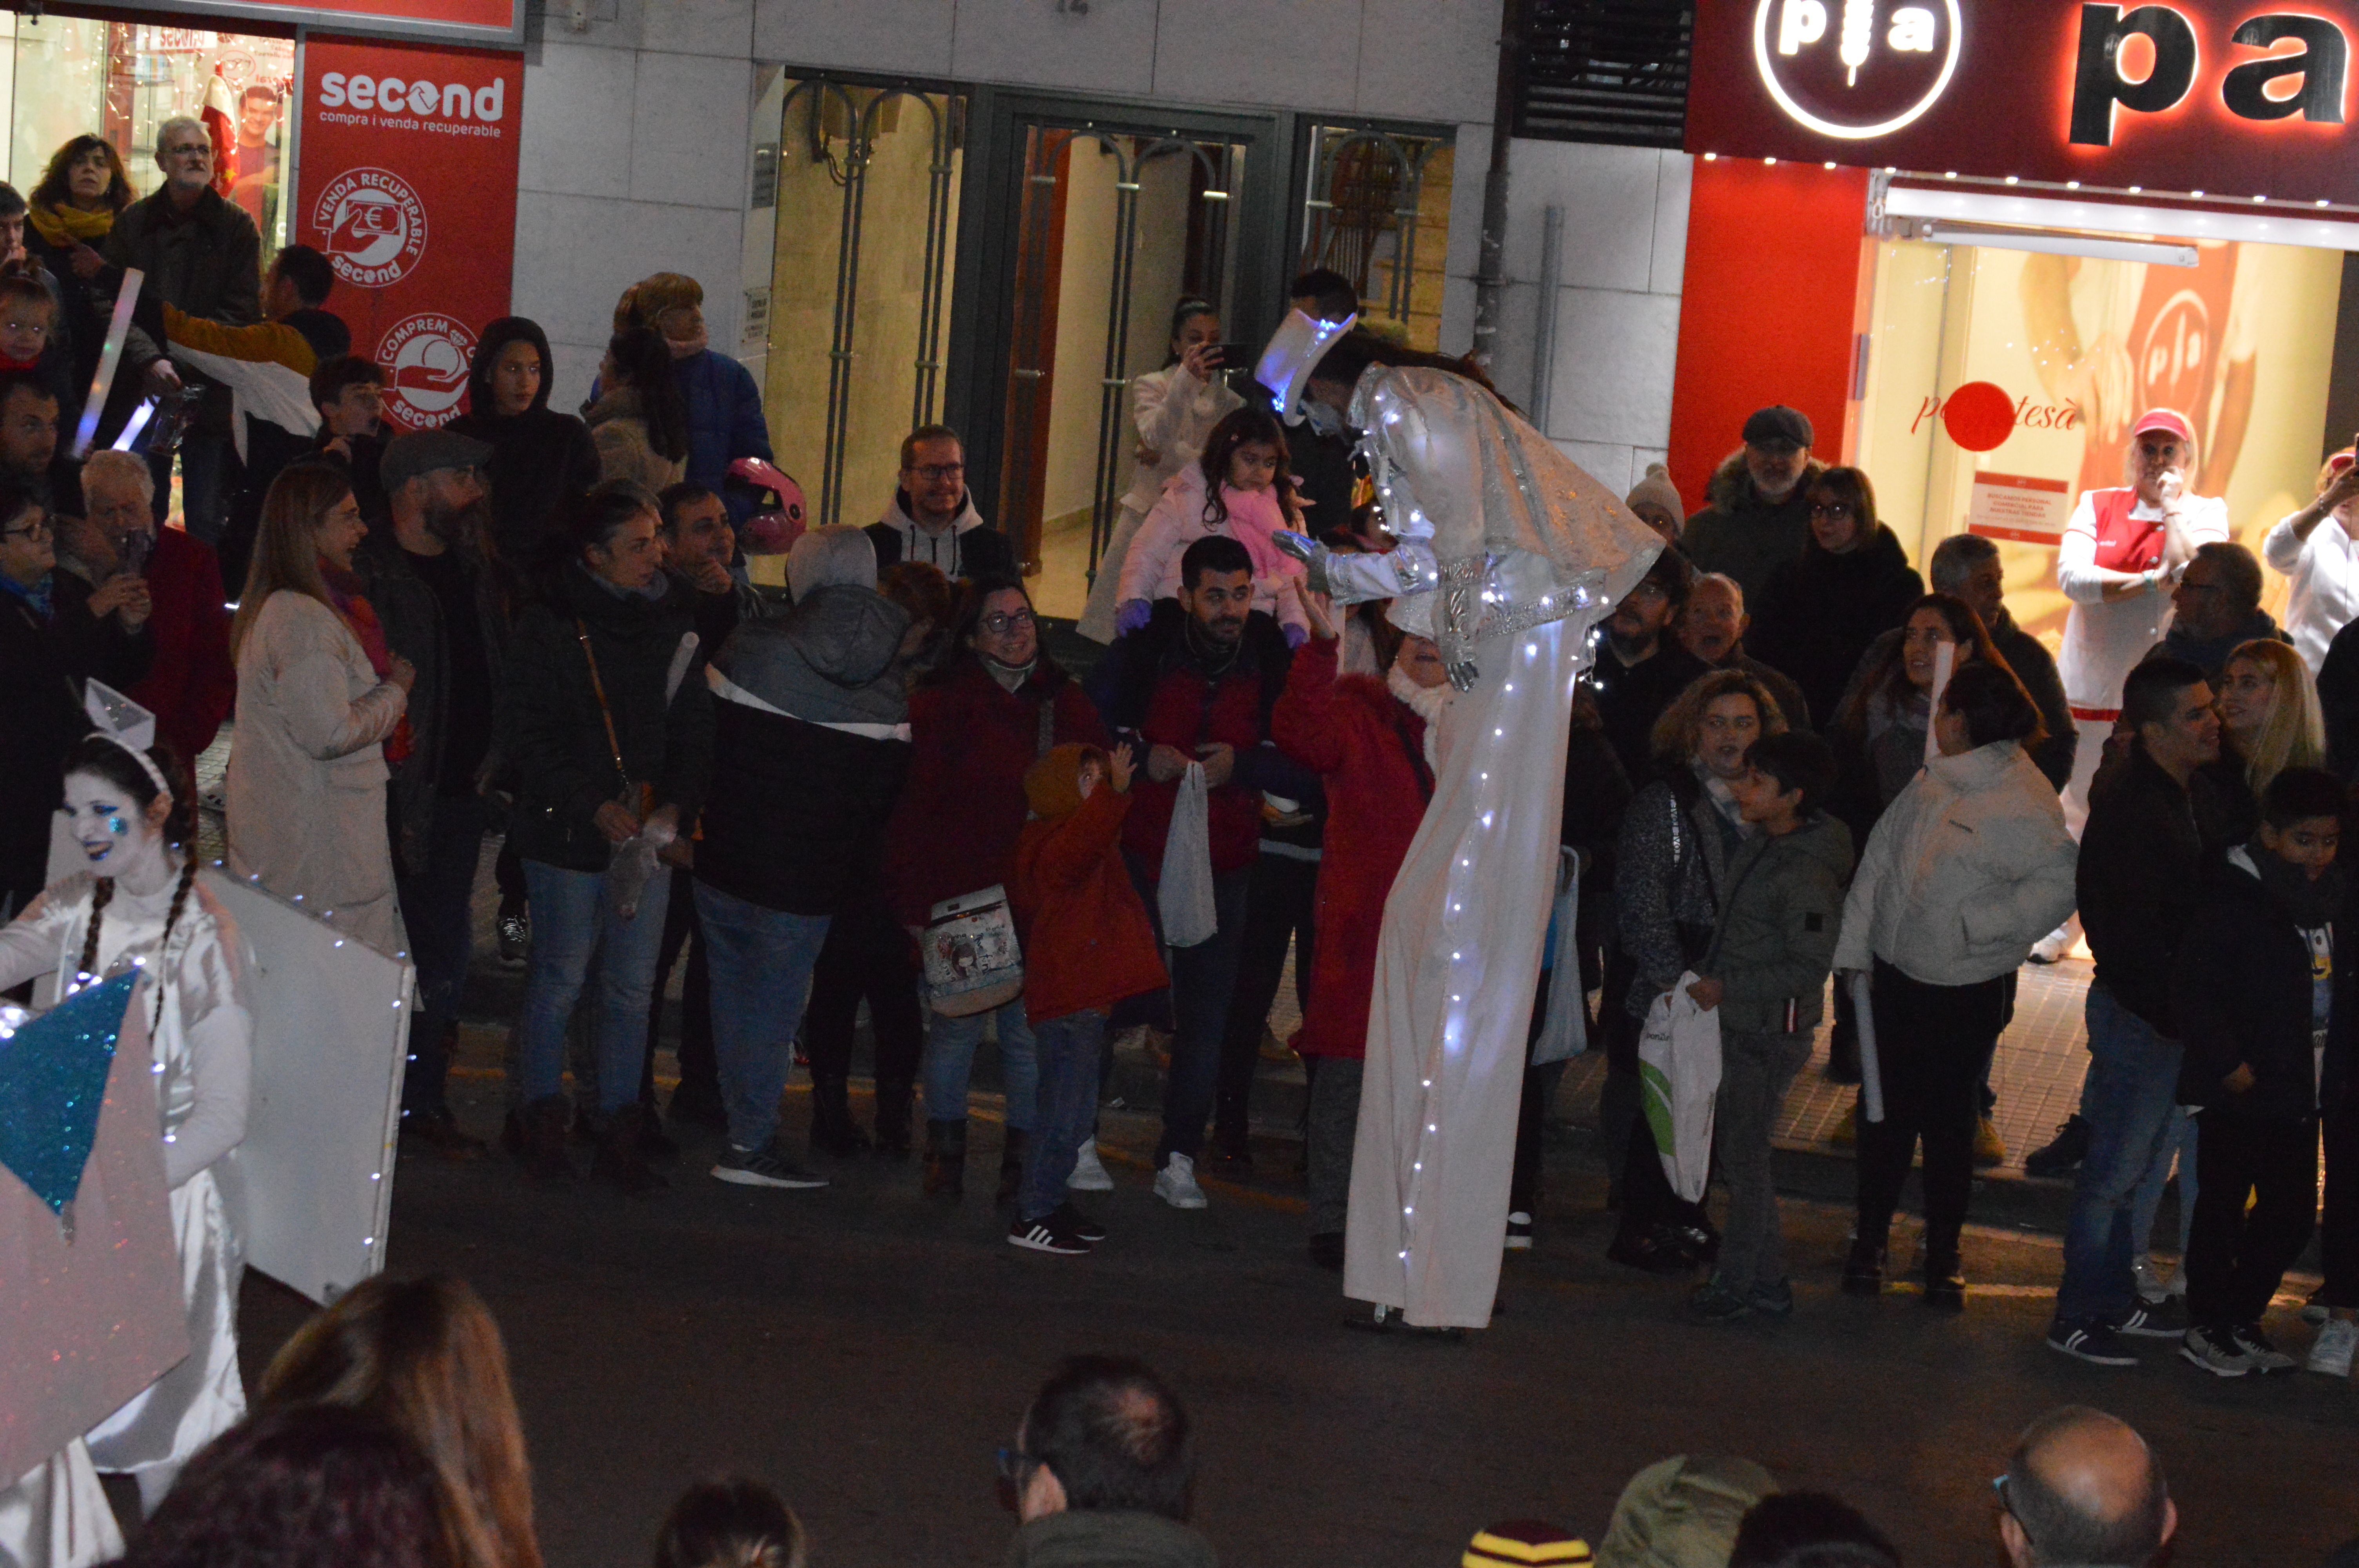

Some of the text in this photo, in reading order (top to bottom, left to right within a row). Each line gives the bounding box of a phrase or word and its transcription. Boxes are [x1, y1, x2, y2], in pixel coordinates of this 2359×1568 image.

[320, 72, 504, 122] second
[2069, 2, 2347, 147] pa
[320, 111, 501, 138] compra i venda recuperable
[319, 173, 422, 256] VENDA RECUPERABLE
[331, 255, 402, 283] second
[382, 318, 448, 361] COMPREM
